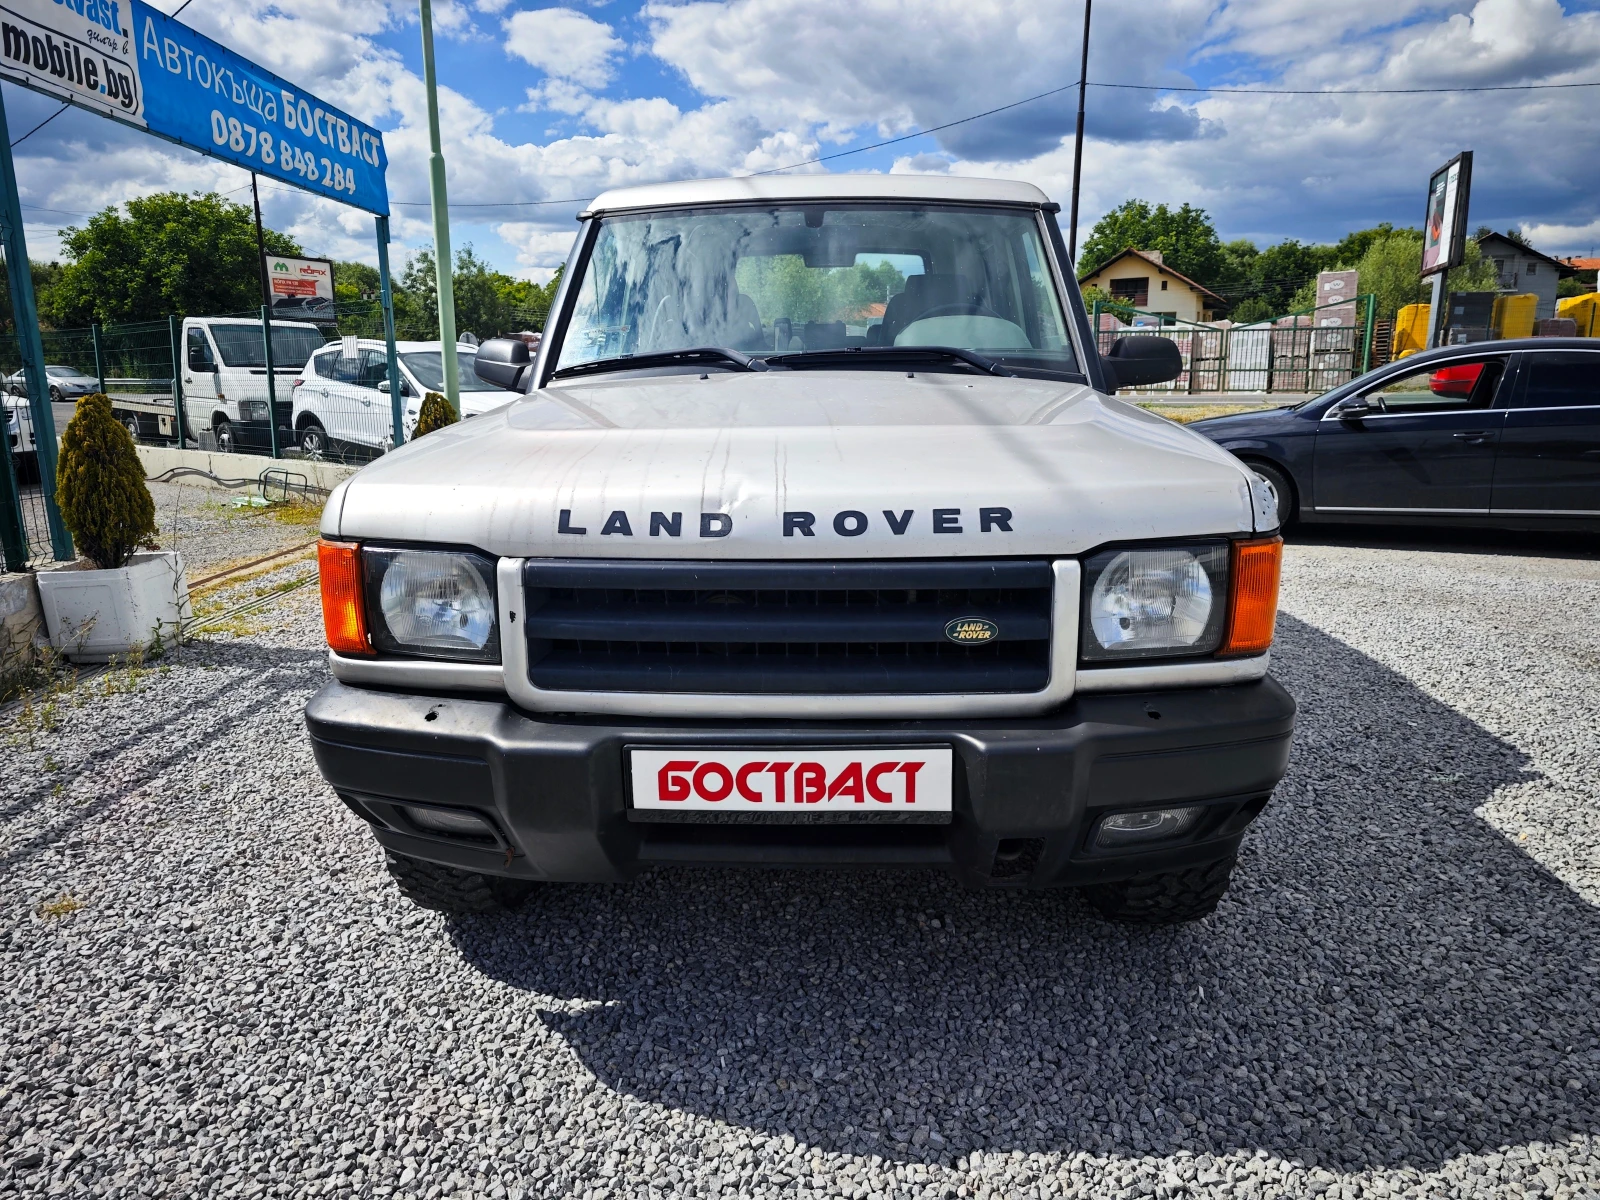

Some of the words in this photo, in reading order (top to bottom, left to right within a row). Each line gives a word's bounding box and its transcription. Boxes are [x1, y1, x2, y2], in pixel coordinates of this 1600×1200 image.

[2, 21, 134, 109] mobile.bg
[281, 89, 381, 168] БОСТВАСТ
[210, 109, 276, 164] 0878
[280, 139, 319, 181] 848
[321, 157, 356, 195] 284
[558, 508, 734, 538] LAND
[783, 506, 1014, 538] ROVER
[957, 623, 983, 631] LAND
[958, 630, 991, 639] ROVER
[657, 760, 926, 804] БОСТВАСТ
